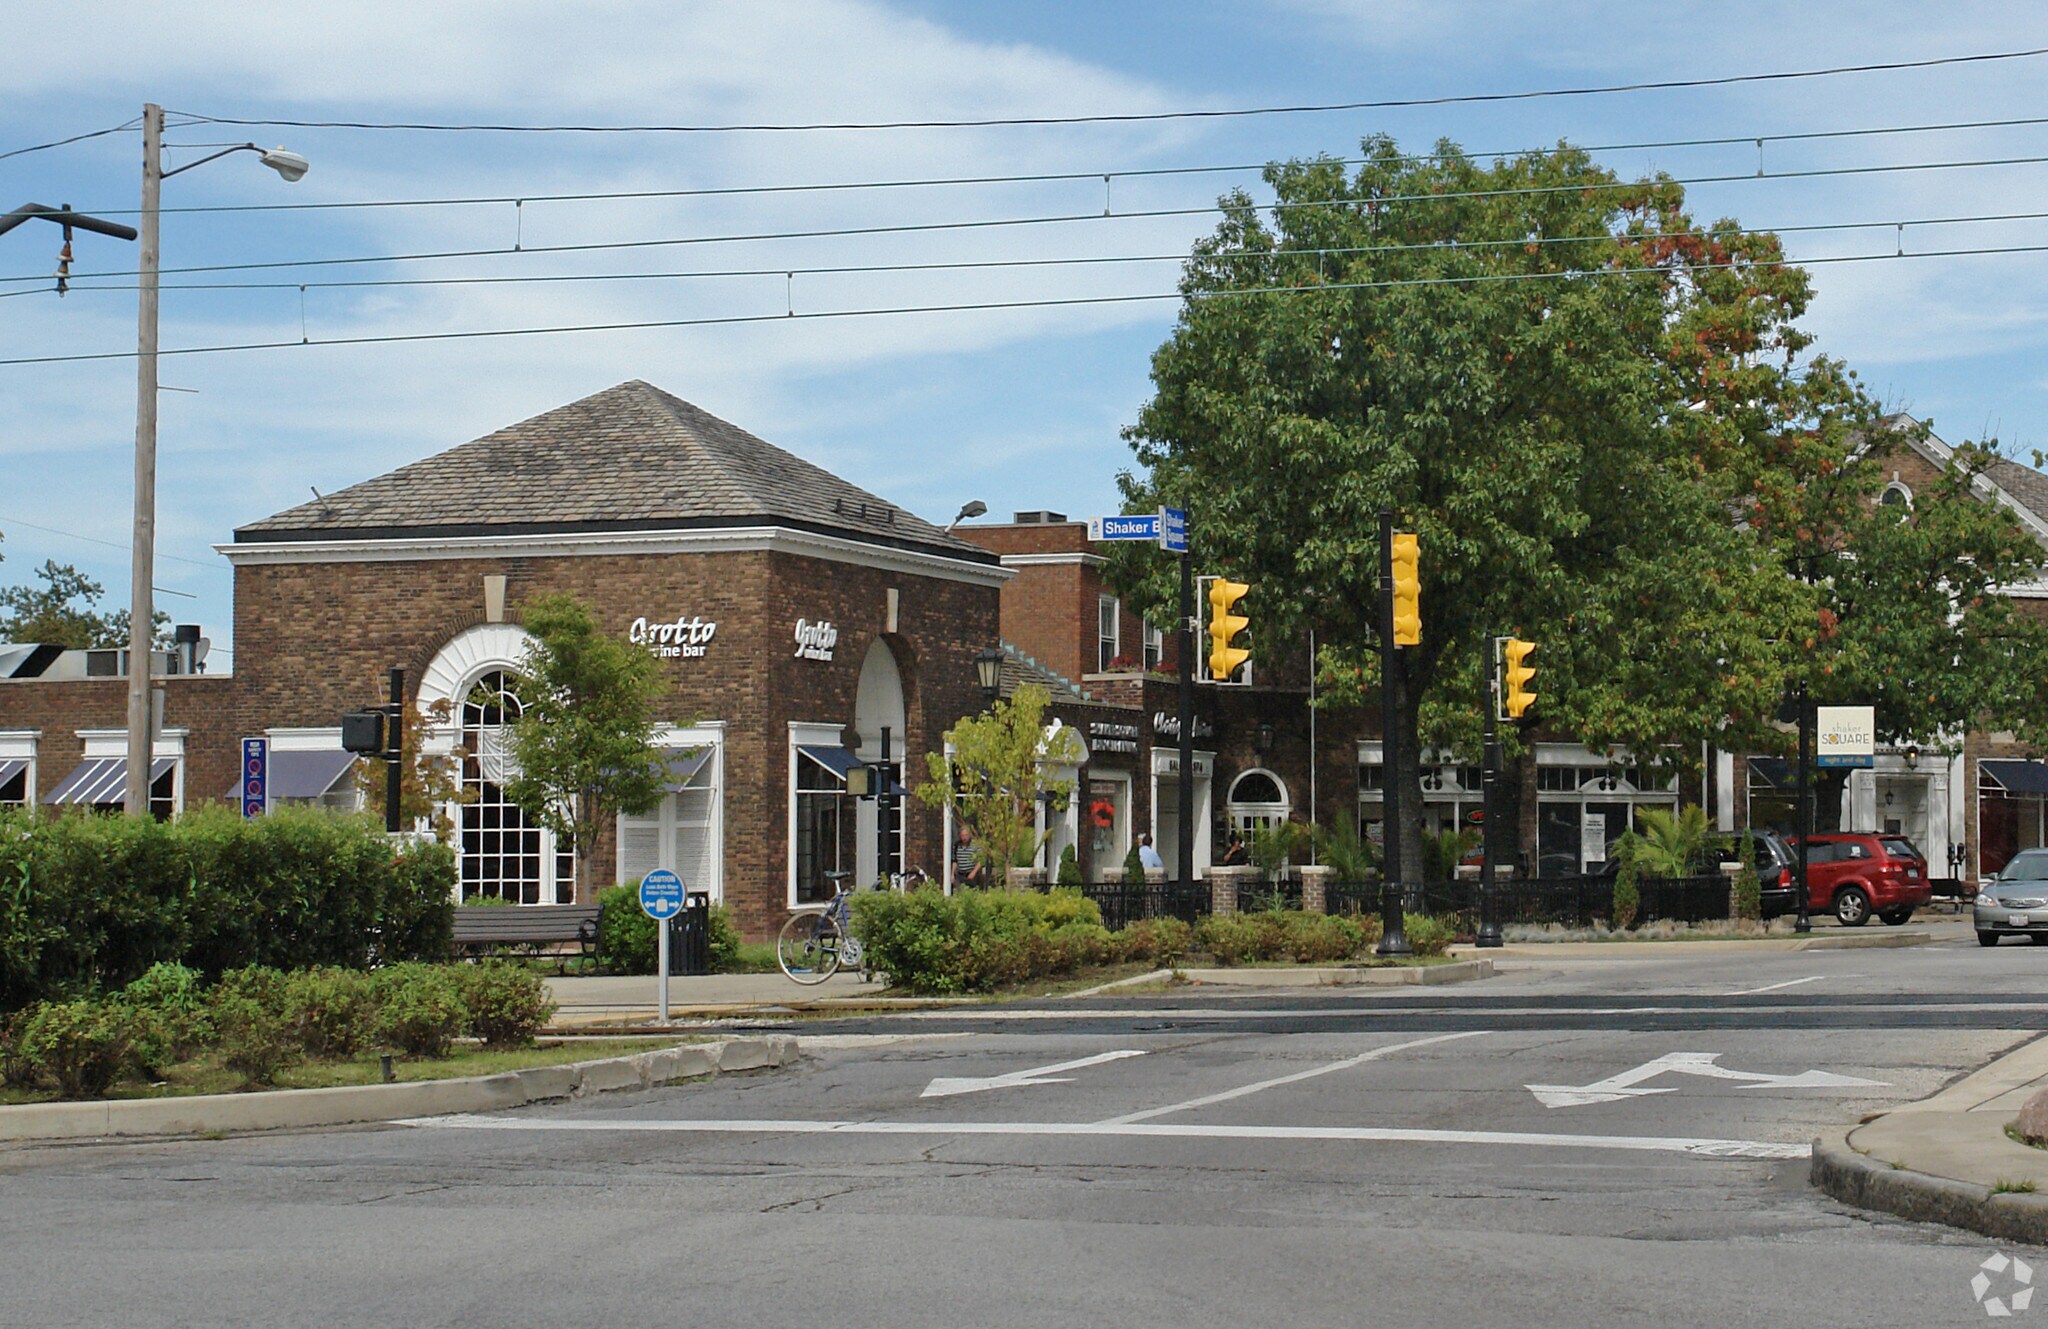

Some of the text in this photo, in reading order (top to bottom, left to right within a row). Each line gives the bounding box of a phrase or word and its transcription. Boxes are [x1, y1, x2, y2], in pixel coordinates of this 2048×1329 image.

[1105, 521, 1148, 534] Shaker
[682, 643, 706, 657] bar
[649, 875, 675, 883] CAUTION
